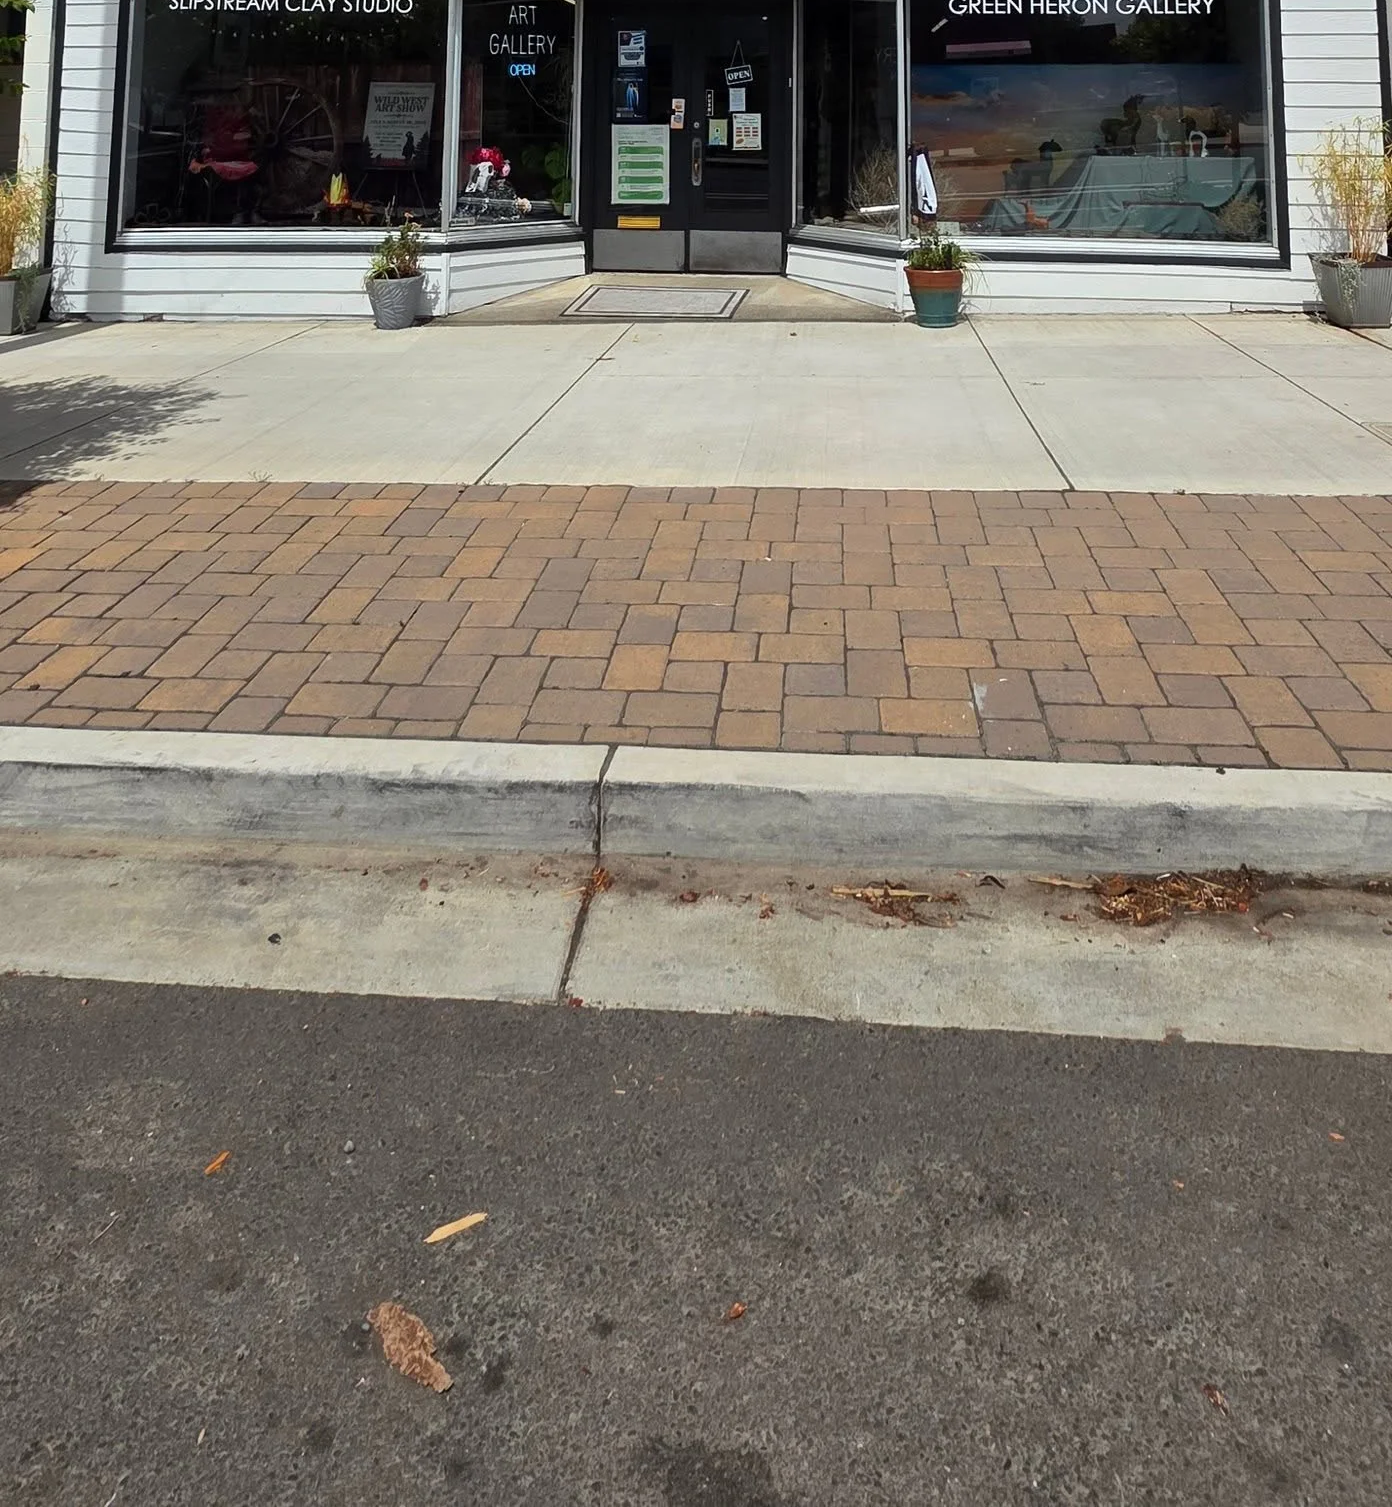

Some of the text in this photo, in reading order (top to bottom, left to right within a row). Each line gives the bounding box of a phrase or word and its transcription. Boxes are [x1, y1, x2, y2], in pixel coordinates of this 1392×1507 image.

[508, 5, 538, 25] ART
[489, 33, 556, 55] GALLERY
[509, 63, 536, 77] OPEN
[727, 69, 751, 81] OPEN
[374, 95, 430, 106] WILD WEST
[375, 103, 425, 113] ART SHOW
